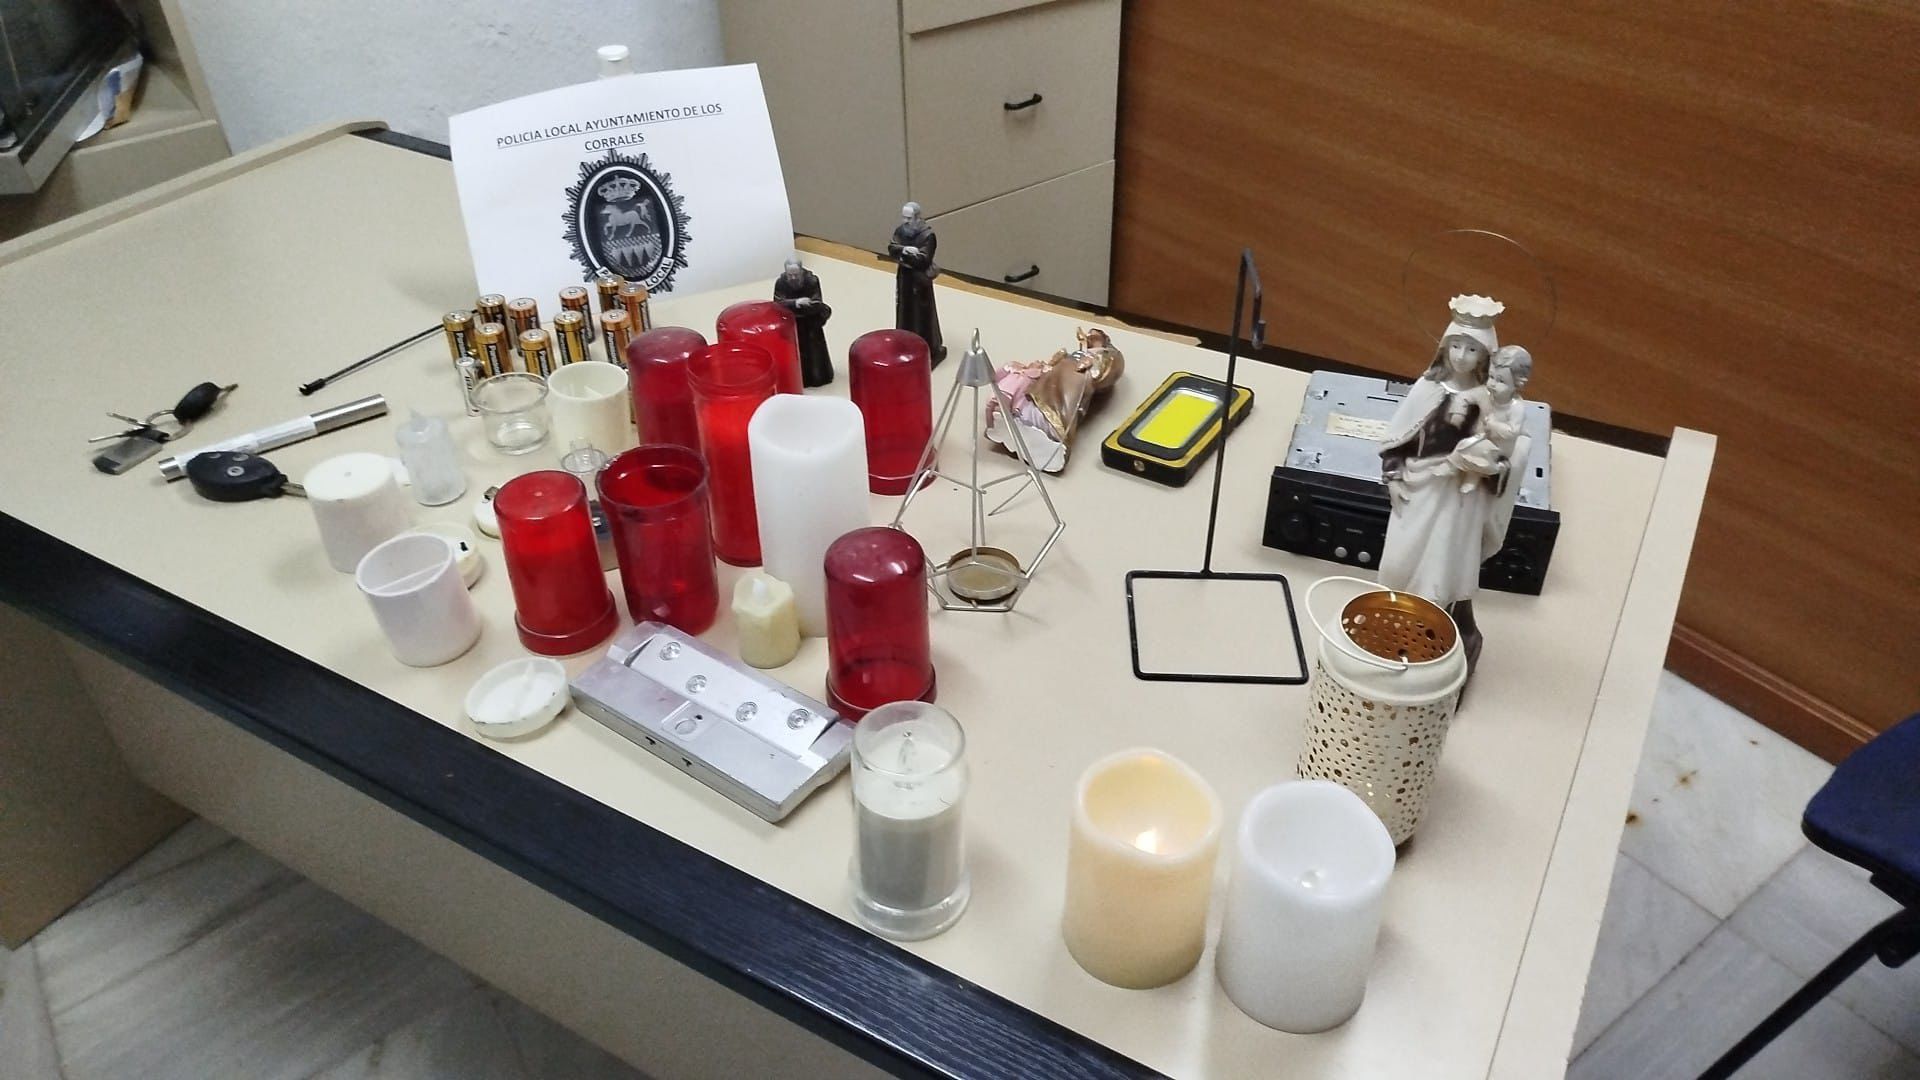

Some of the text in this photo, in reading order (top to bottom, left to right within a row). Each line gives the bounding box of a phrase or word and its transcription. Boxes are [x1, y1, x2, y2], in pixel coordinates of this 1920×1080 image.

[496, 103, 722, 147] POLICIA LOCAL AYUNTAMIENTO DE LOS
[584, 132, 645, 151] CORRALES
[645, 260, 672, 287] LOCAL
